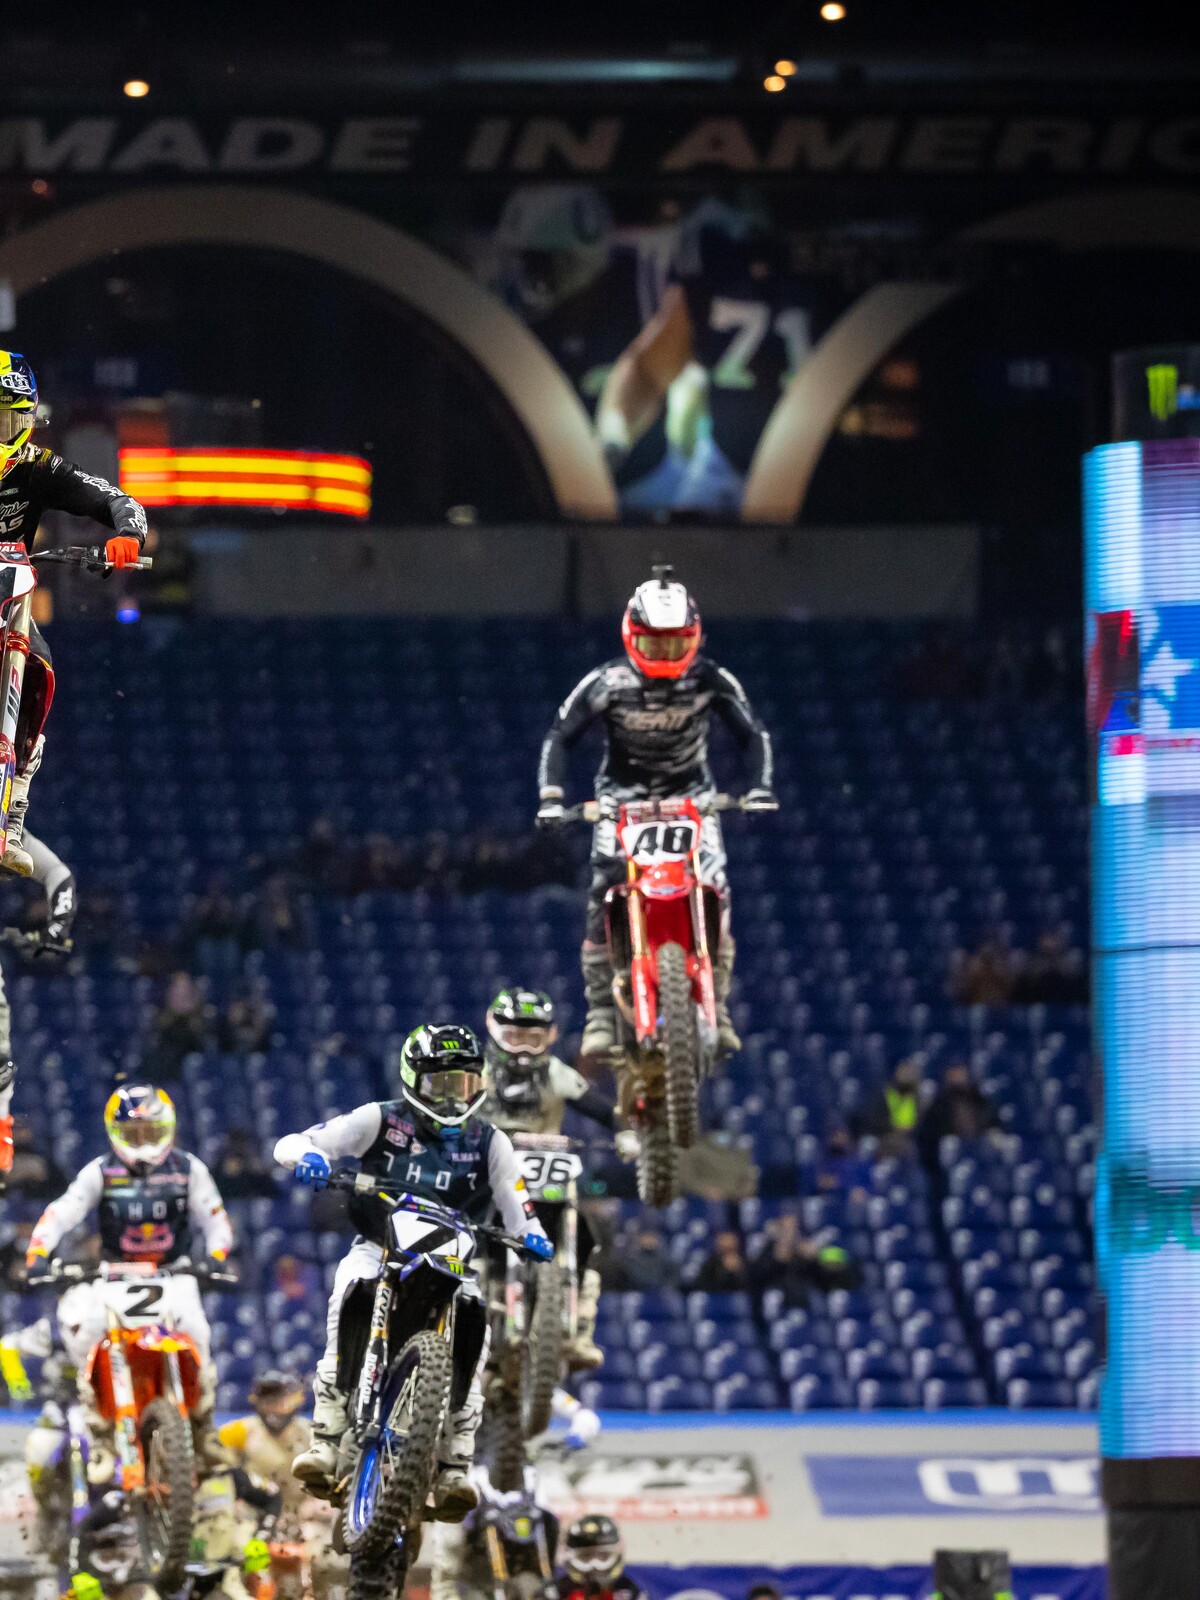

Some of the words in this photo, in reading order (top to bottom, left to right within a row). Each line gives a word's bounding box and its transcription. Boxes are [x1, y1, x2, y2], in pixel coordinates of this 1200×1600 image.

[457, 116, 623, 170] IN
[632, 825, 693, 857] 40
[522, 1155, 573, 1184] 36
[406, 1215, 459, 1256] 7
[124, 1284, 164, 1317] 2
